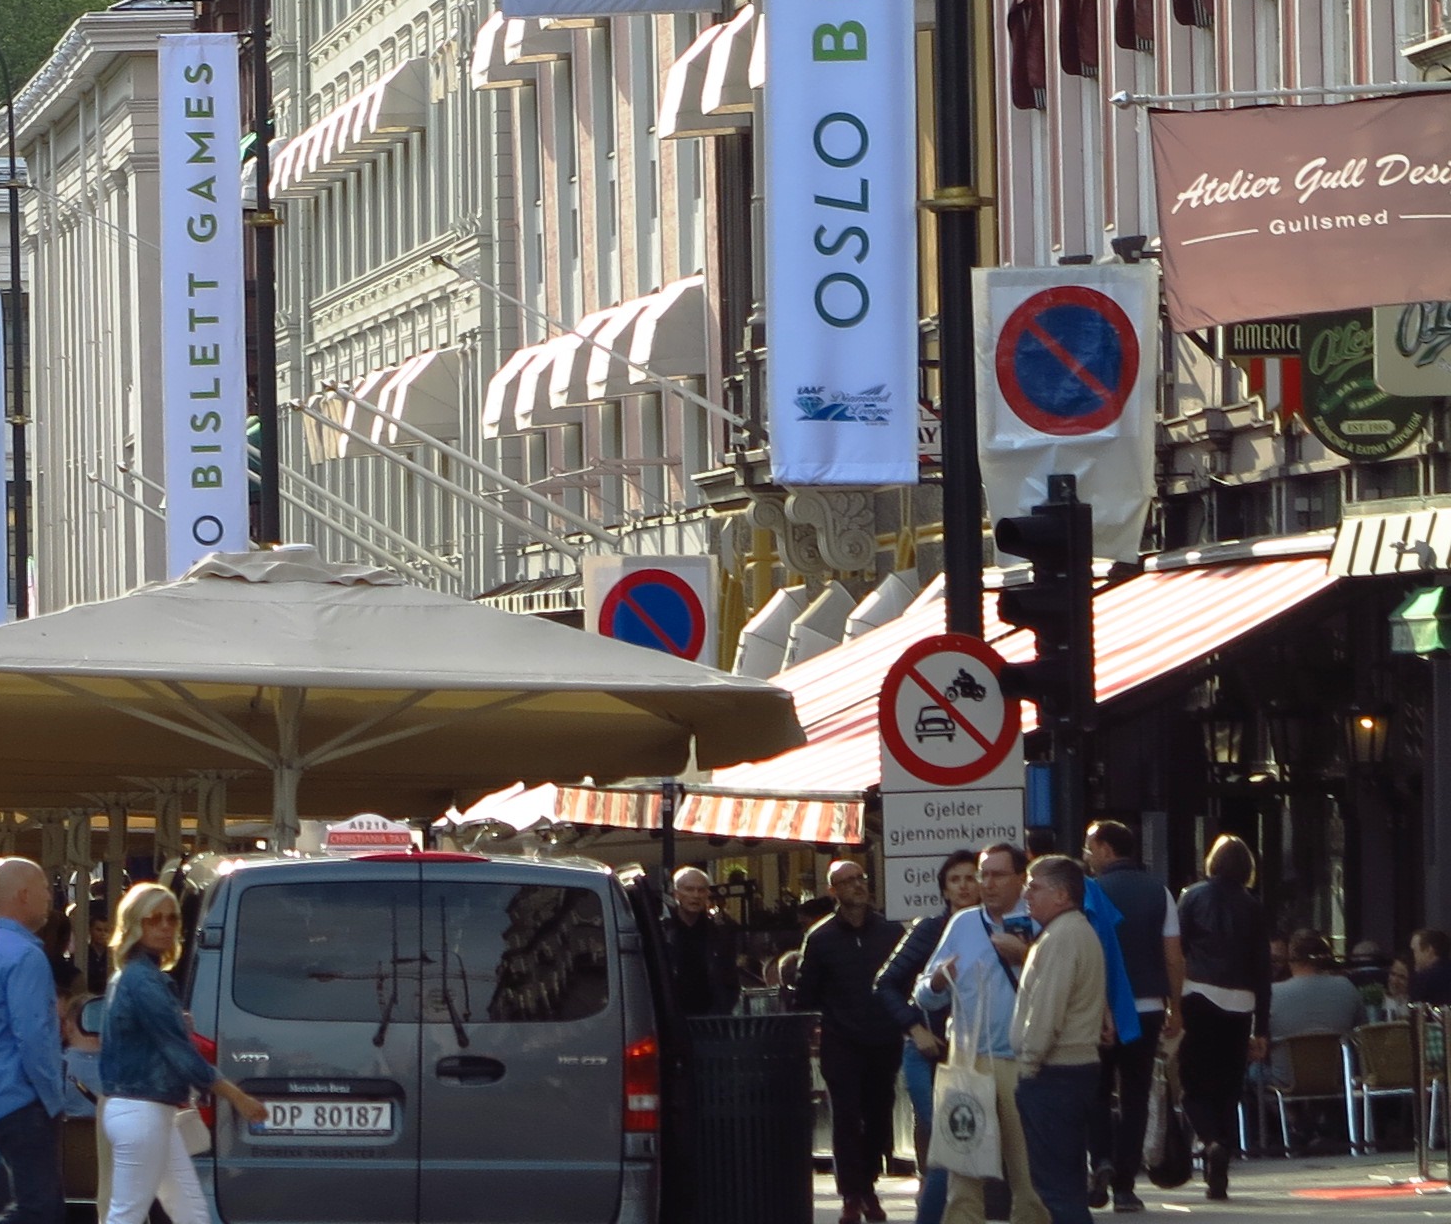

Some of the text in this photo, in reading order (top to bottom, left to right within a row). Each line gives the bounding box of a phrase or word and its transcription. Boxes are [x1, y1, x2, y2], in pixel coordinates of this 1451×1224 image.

[185, 61, 218, 244] GAMES
[1171, 169, 1281, 214] Atelier
[1295, 157, 1368, 204] Gull
[812, 112, 870, 328] OSLO
[1269, 210, 1389, 235] Gullsmed
[189, 272, 223, 490] BISLETT
[924, 801, 983, 821] Gjelder
[890, 822, 1017, 845] gjennomkjøring
[904, 868, 939, 887] Gjel
[272, 1105, 384, 1127] DP 80187
